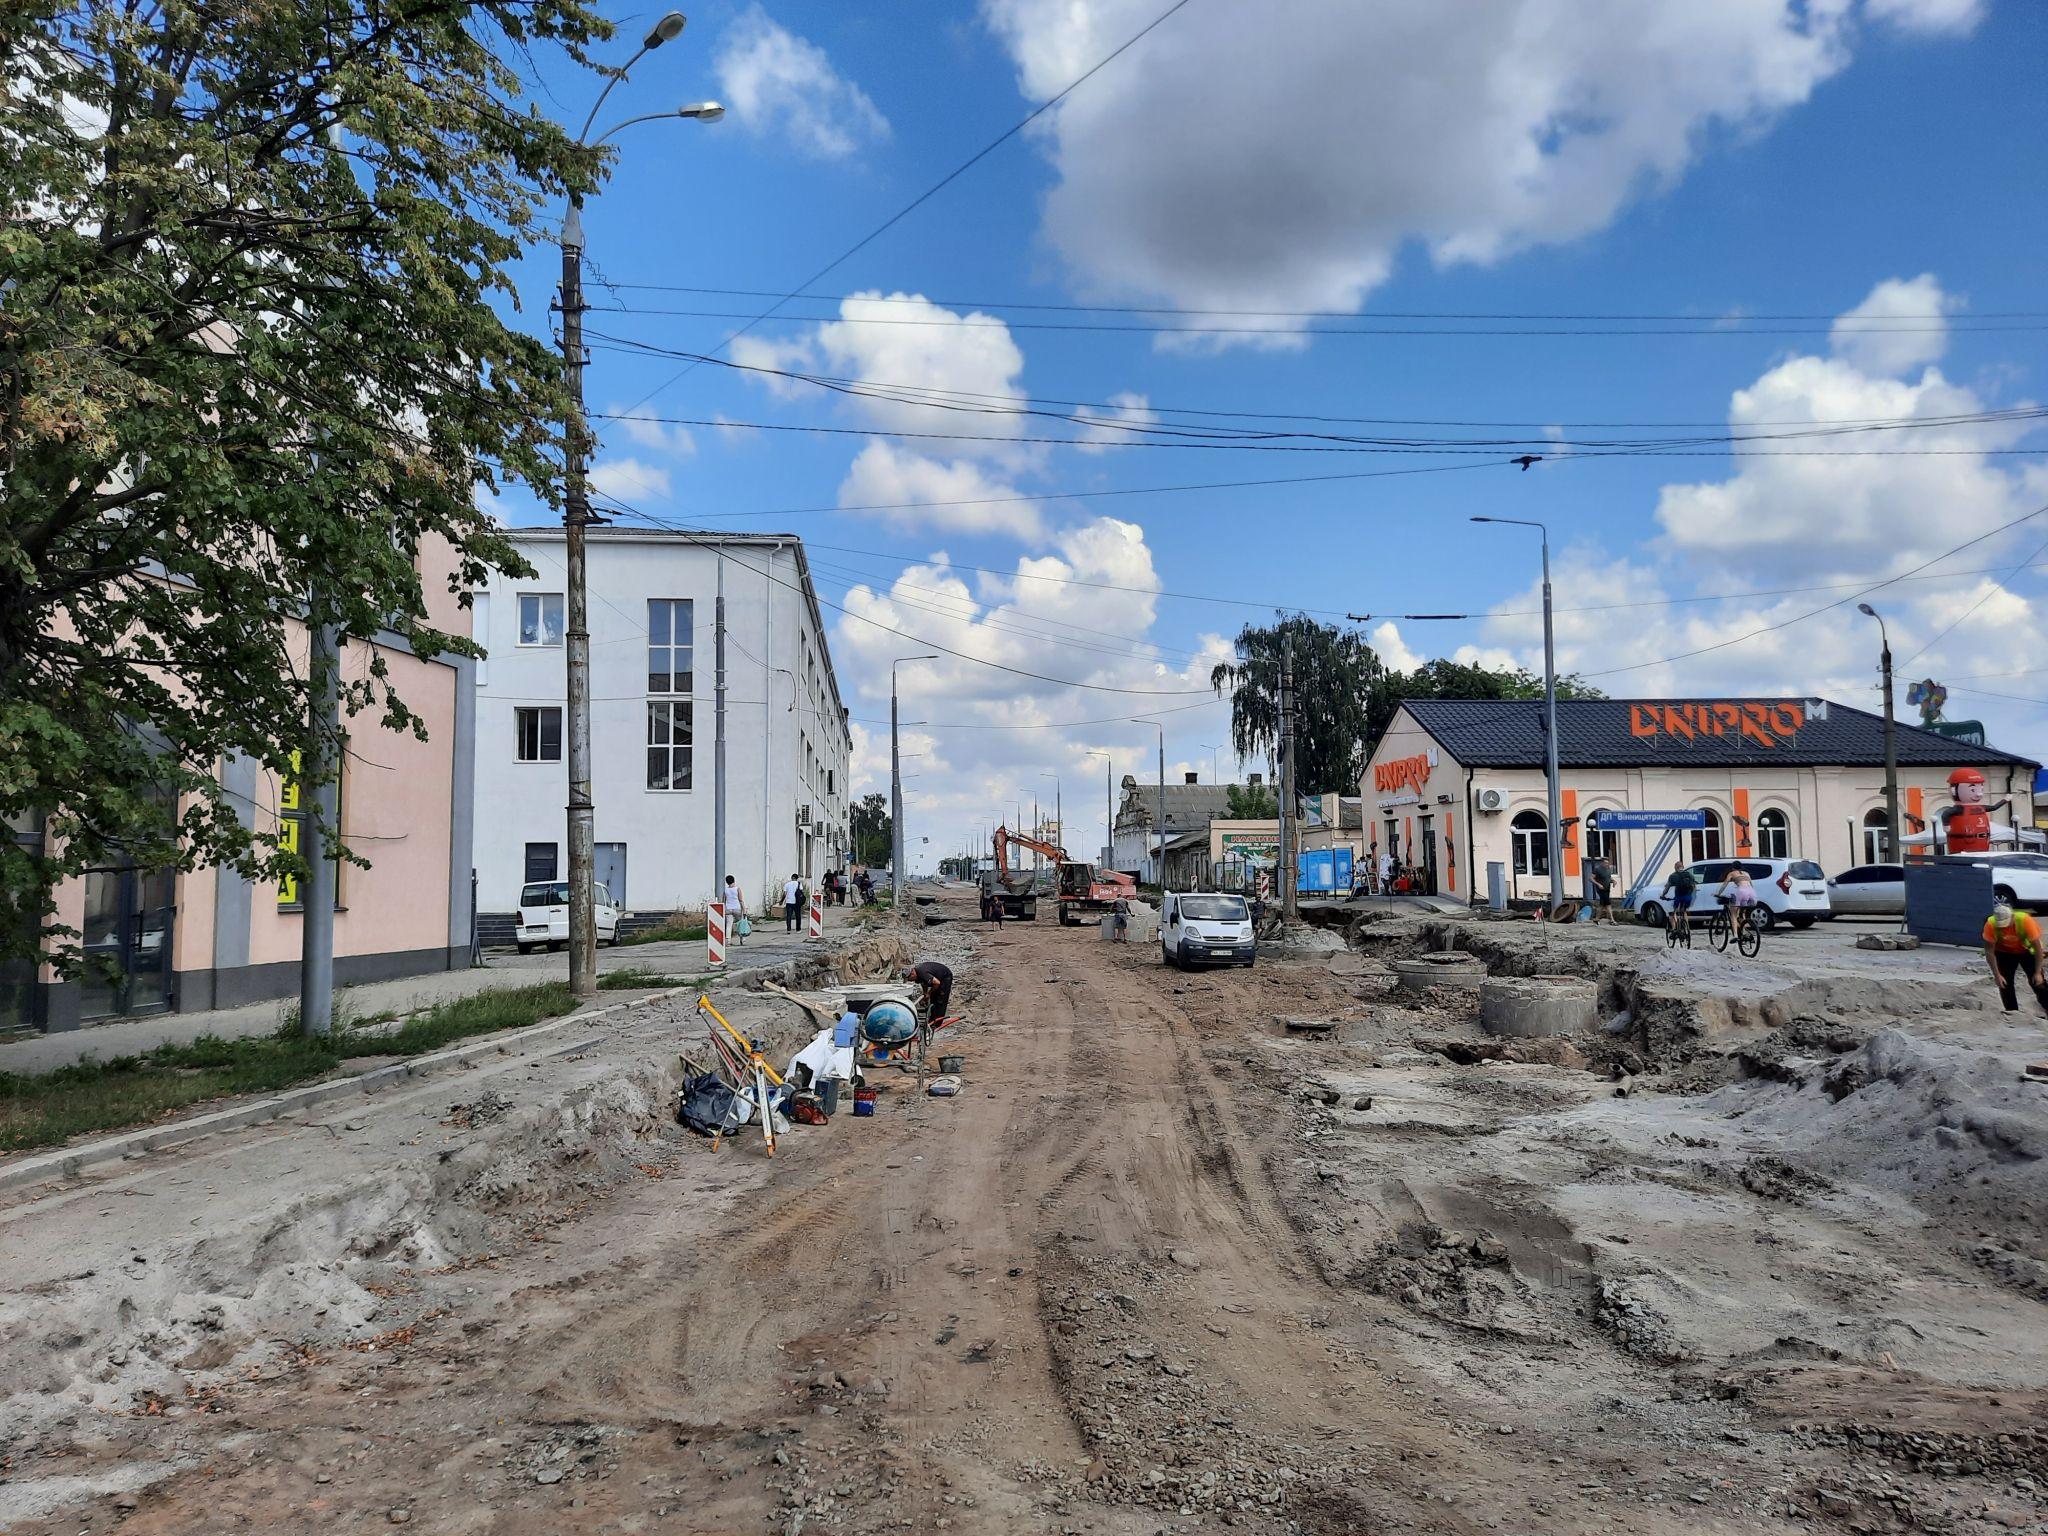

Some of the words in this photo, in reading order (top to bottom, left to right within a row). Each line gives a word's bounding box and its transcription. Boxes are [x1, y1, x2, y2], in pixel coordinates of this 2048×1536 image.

[1630, 703, 1804, 747] DNIPRO
[1375, 754, 1430, 794] DNIPRO
[1600, 813, 1612, 822] ДП
